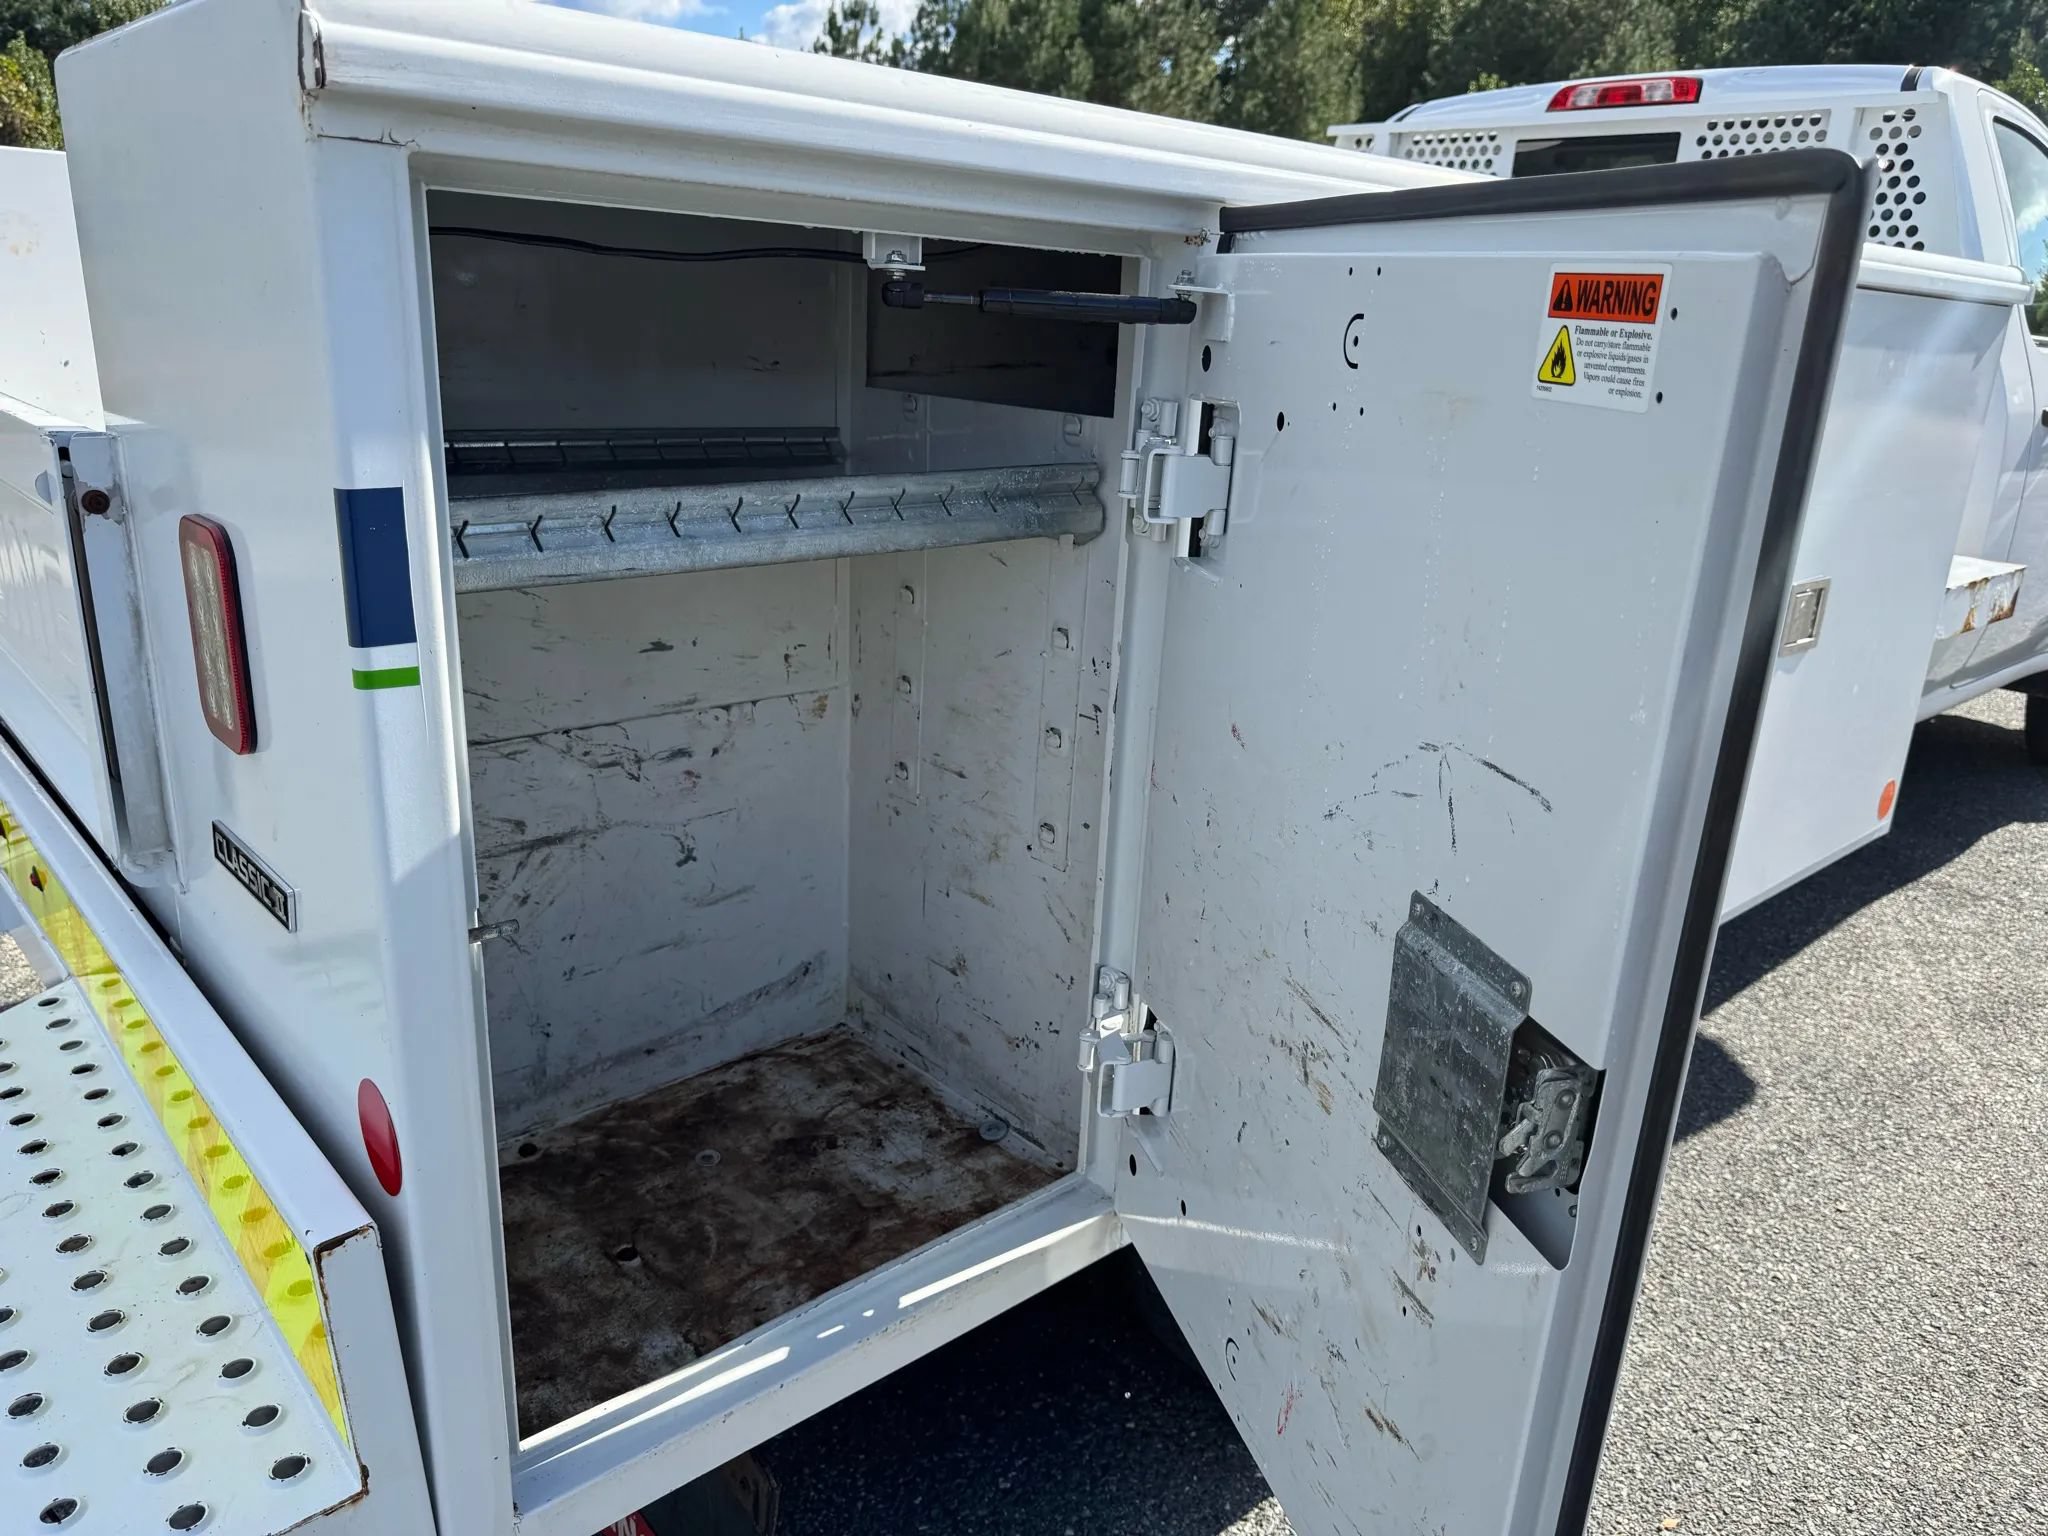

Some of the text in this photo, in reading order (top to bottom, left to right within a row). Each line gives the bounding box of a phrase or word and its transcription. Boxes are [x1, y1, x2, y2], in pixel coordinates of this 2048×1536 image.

[1576, 279, 1657, 316] WARNING
[1574, 325, 1653, 341] Flammable or Explosive.
[1576, 337, 1652, 352] Do not carry/store flammable
[1583, 350, 1607, 360] explosive
[1608, 352, 1642, 364] liquids/gases
[1584, 362, 1607, 372] unvented
[1584, 371, 1600, 383] Vapors
[1601, 374, 1616, 383] could
[1632, 377, 1645, 387] fires
[214, 831, 272, 906] CLASSIC
